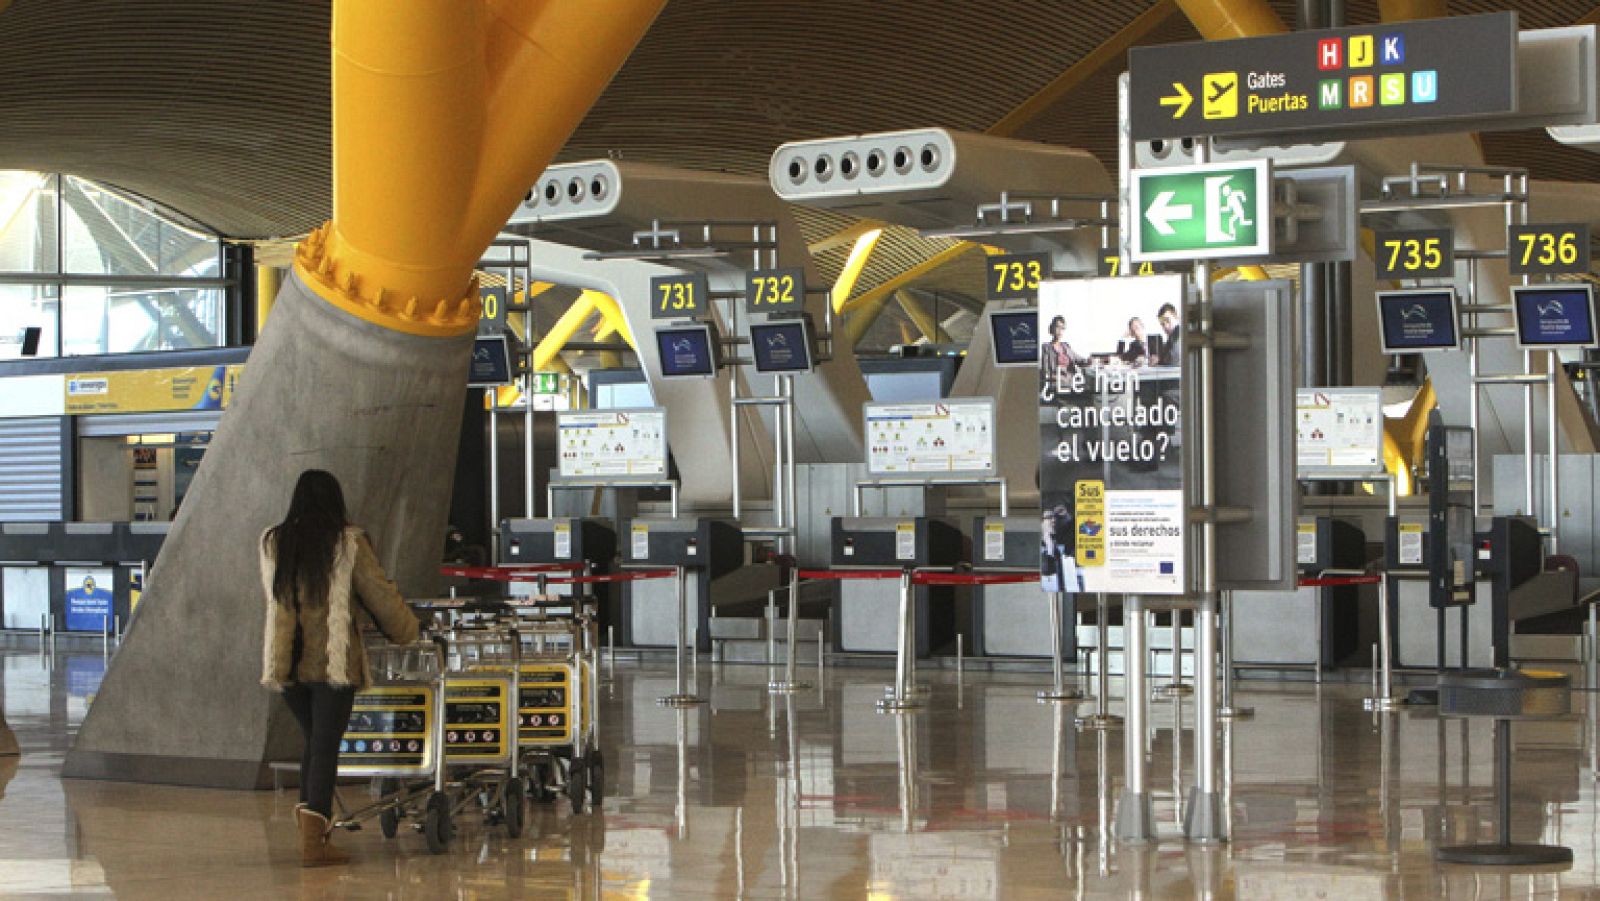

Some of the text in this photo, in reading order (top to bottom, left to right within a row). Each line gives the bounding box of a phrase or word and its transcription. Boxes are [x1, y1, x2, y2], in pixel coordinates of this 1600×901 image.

[1322, 43, 1338, 66] H
[1384, 36, 1400, 61] K
[1247, 71, 1287, 89] Gates
[1322, 73, 1432, 106] M R S U
[1247, 92, 1309, 114] Puertas
[1384, 238, 1442, 272] 735
[1518, 232, 1578, 266] 736
[752, 276, 795, 305] 732
[993, 260, 1042, 293] 733
[659, 282, 696, 311] 731
[1041, 364, 1141, 401] ¿Le han
[1057, 397, 1178, 428] cancelado
[1057, 432, 1170, 462] el vuelo?
[1110, 523, 1180, 537] sus derechos
